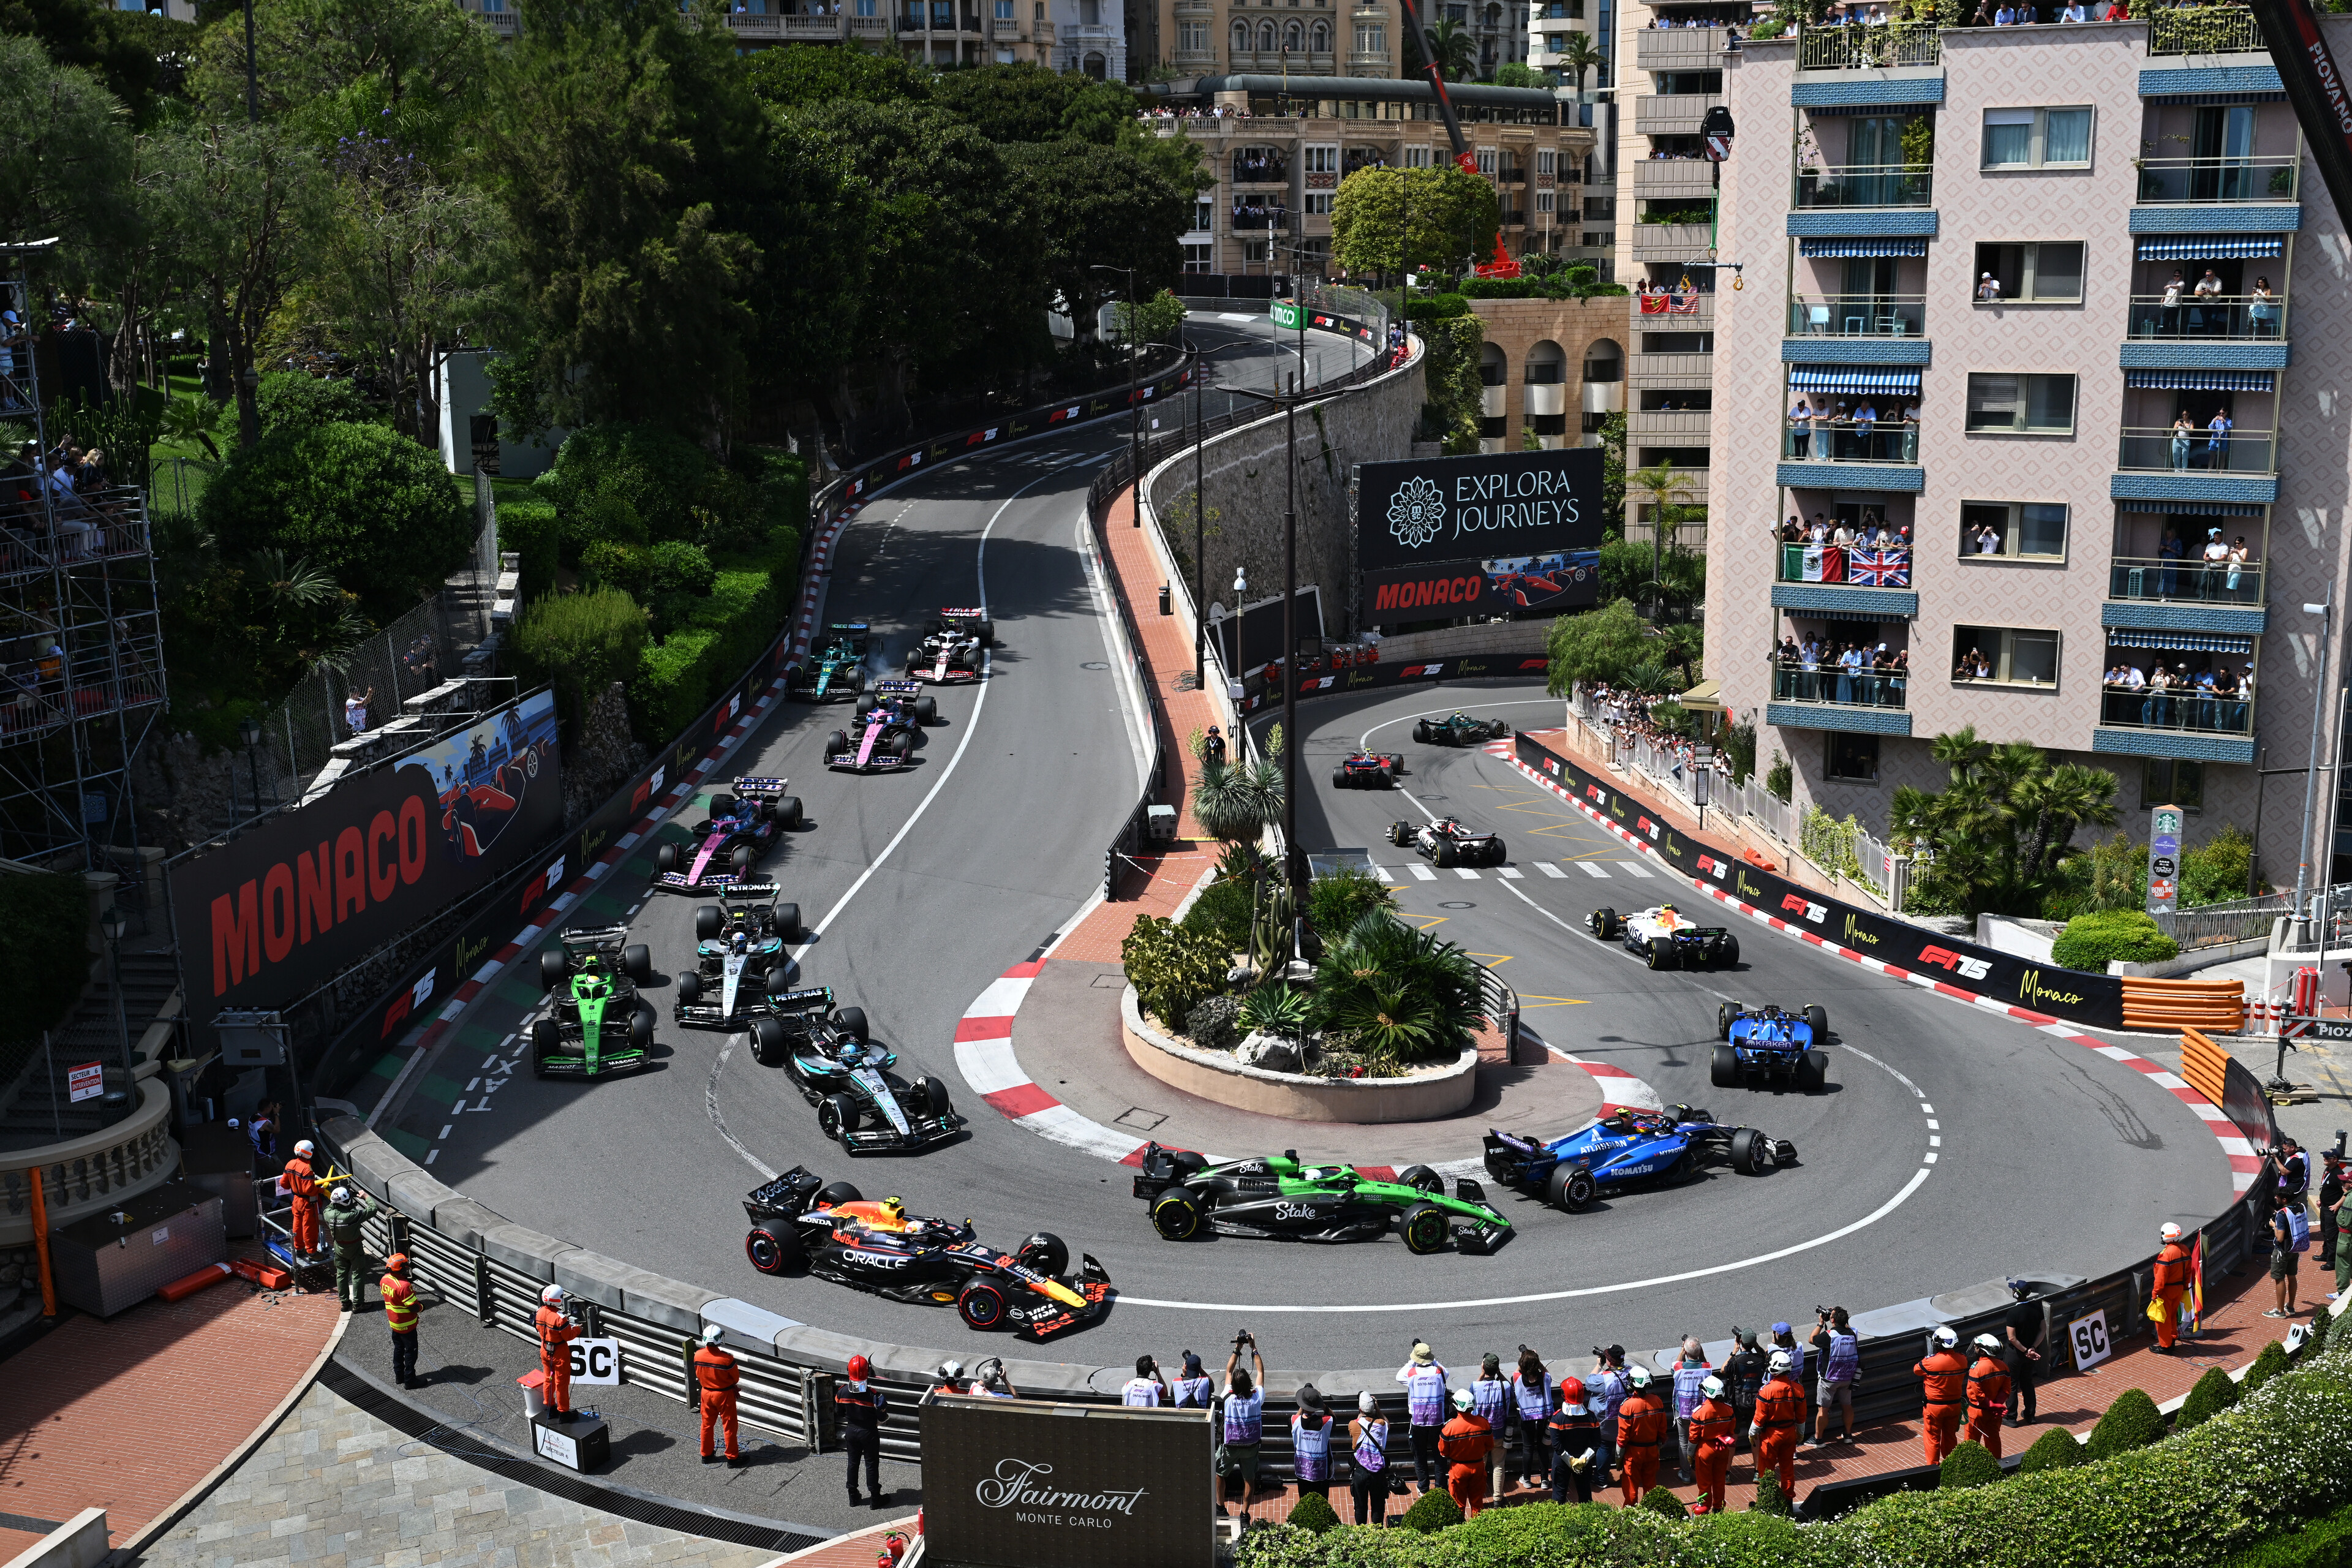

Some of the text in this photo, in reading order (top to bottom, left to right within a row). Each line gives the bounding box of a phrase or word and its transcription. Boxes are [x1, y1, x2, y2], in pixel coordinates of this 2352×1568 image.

[1457, 469, 1570, 502] EXPLORA
[1452, 498, 1580, 541] JOURNEYS
[1375, 575, 1480, 611] MONACO
[1457, 659, 1488, 676] Monaco
[1348, 670, 1374, 690] Monaco
[582, 829, 606, 865] Monaco
[1667, 832, 1681, 859] Monaco
[1737, 870, 1760, 900] Monaco
[211, 795, 426, 997] MONACO
[1627, 923, 1643, 943] VISA
[1844, 913, 1880, 948] Monaco
[455, 936, 489, 978] Monaco
[775, 989, 823, 1001] PETRONAS
[2019, 969, 2083, 1008] Monaco
[1754, 1039, 1792, 1049] kraken
[71, 1070, 90, 1080] SECTEUR
[72, 1077, 100, 1090] INTERVENTION
[1504, 1135, 1531, 1152] kraken
[1580, 1139, 1627, 1155] ATLASSIAN
[1659, 1145, 1687, 1156] MYPROTEIN
[1239, 1163, 1264, 1174] Stake
[1611, 1164, 1653, 1176] KOMATSU
[1275, 1201, 1316, 1220] Stake
[797, 1216, 833, 1226] HONDA
[1458, 1226, 1476, 1236] Stake
[843, 1249, 909, 1270] ORACLE
[1033, 1313, 1074, 1336] Red
[2076, 1319, 2105, 1360] SC
[569, 1344, 612, 1378] SC
[546, 1446, 565, 1458] SECTEUR
[975, 1458, 1150, 1515] Fairmont
[1016, 1512, 1112, 1529] MONTE CARLO
